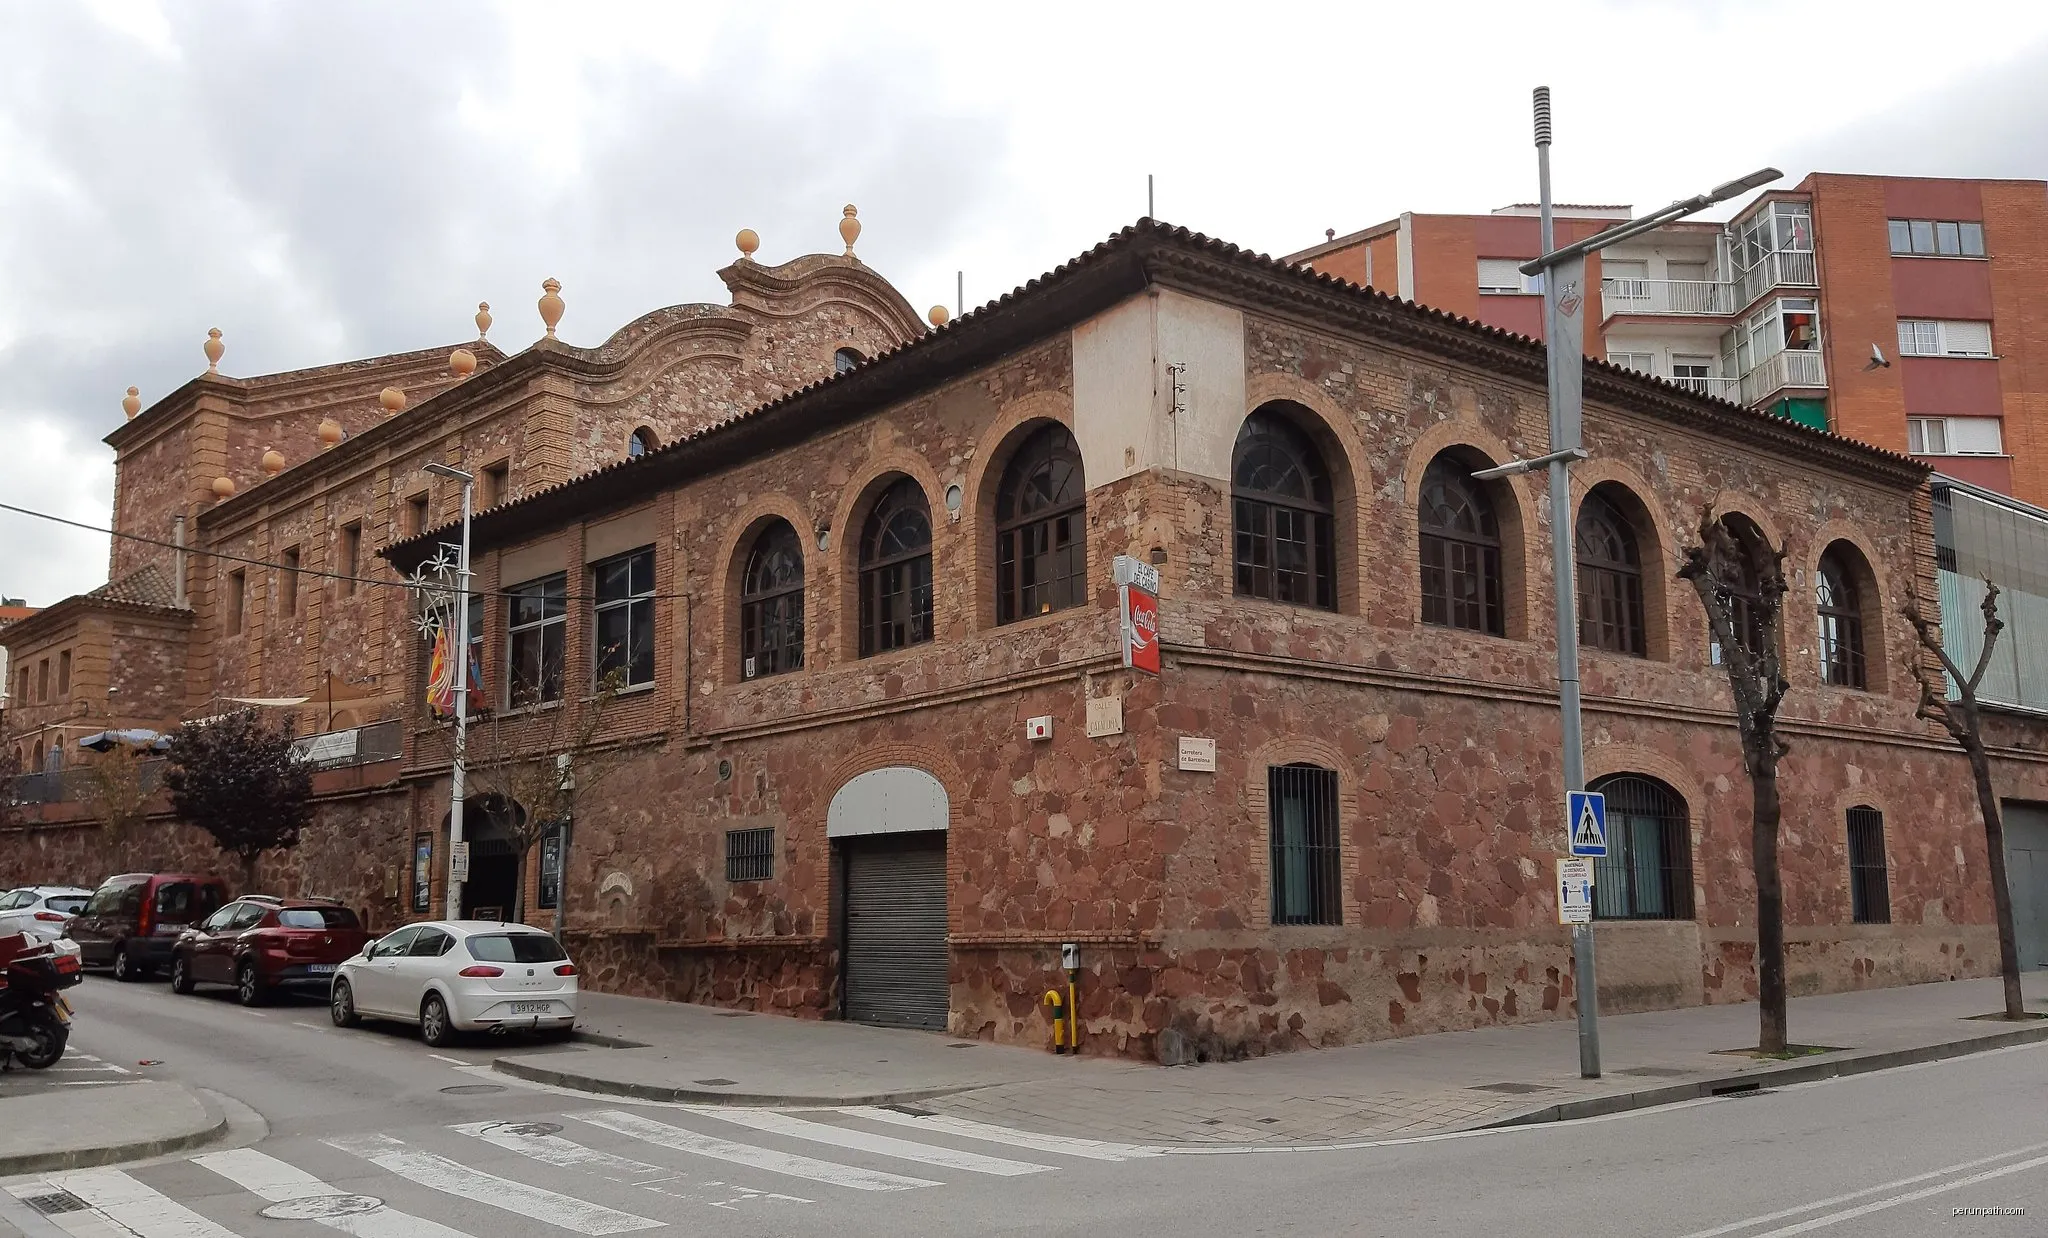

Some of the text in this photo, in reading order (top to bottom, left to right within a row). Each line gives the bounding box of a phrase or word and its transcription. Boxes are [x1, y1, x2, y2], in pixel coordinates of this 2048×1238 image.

[1133, 572, 1157, 593] DEL CASINO
[1095, 701, 1113, 710] CALLE
[516, 1004, 535, 1012] 3912
